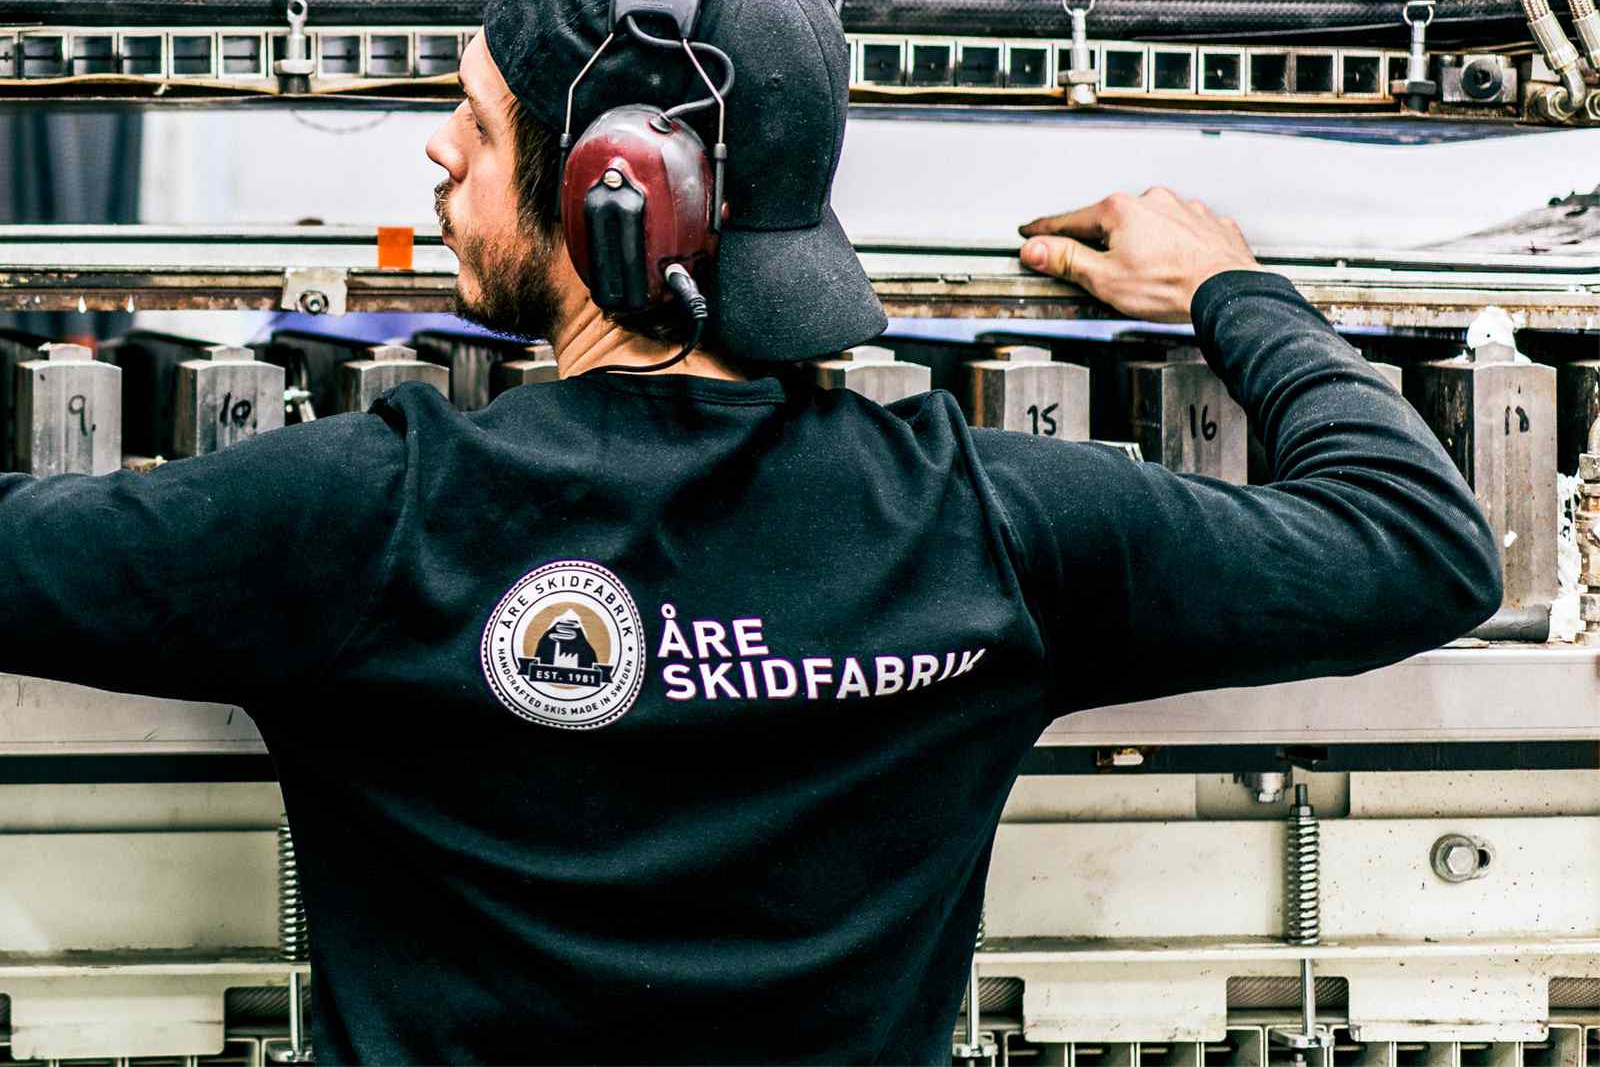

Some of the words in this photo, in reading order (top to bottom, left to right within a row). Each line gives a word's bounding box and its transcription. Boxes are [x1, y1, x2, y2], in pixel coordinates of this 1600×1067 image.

[1026, 403, 1059, 436] 15
[1189, 404, 1218, 441] 16
[500, 595, 530, 630] ÅRE
[535, 575, 634, 637] SKIDFABRIK
[657, 603, 769, 659] ÅRE
[498, 648, 542, 708] HANDCRAFTED
[543, 704, 568, 716] SKIS
[570, 703, 599, 716] MADE
[600, 696, 611, 707] IN
[611, 660, 633, 698] SWEDEN
[536, 671, 563, 681] EST.
[568, 672, 596, 684] 1981
[663, 648, 987, 701] SKIDFABRIK
